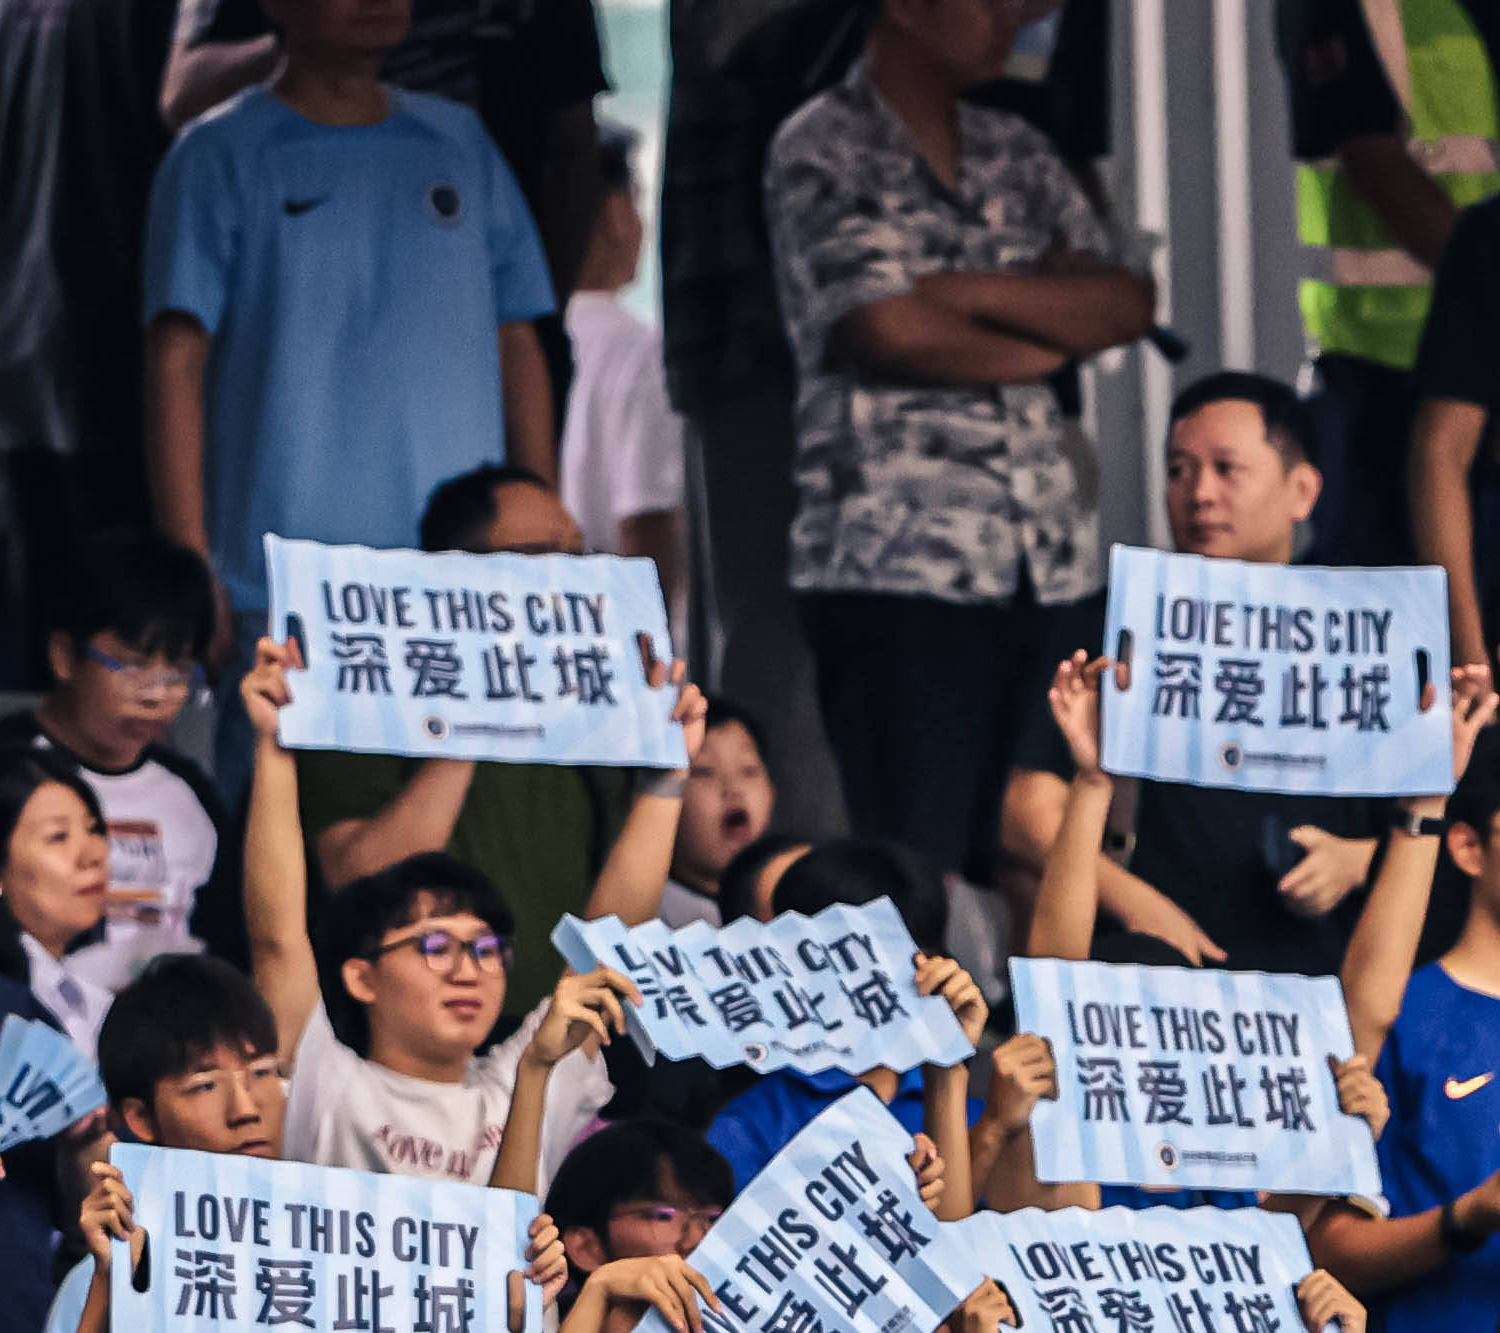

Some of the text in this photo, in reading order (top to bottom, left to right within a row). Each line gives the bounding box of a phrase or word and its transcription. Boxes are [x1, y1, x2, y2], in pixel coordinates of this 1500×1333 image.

[321, 580, 604, 637] LOVE THIS CITY
[330, 631, 618, 706] 深爱此城
[1151, 650, 1391, 733] 深爱此城
[1067, 1000, 1300, 1057] LOVE THIS CITY
[1076, 1055, 1316, 1132] 深爱此城
[735, 1208, 820, 1294] THIS
[805, 1140, 880, 1222] CITY
